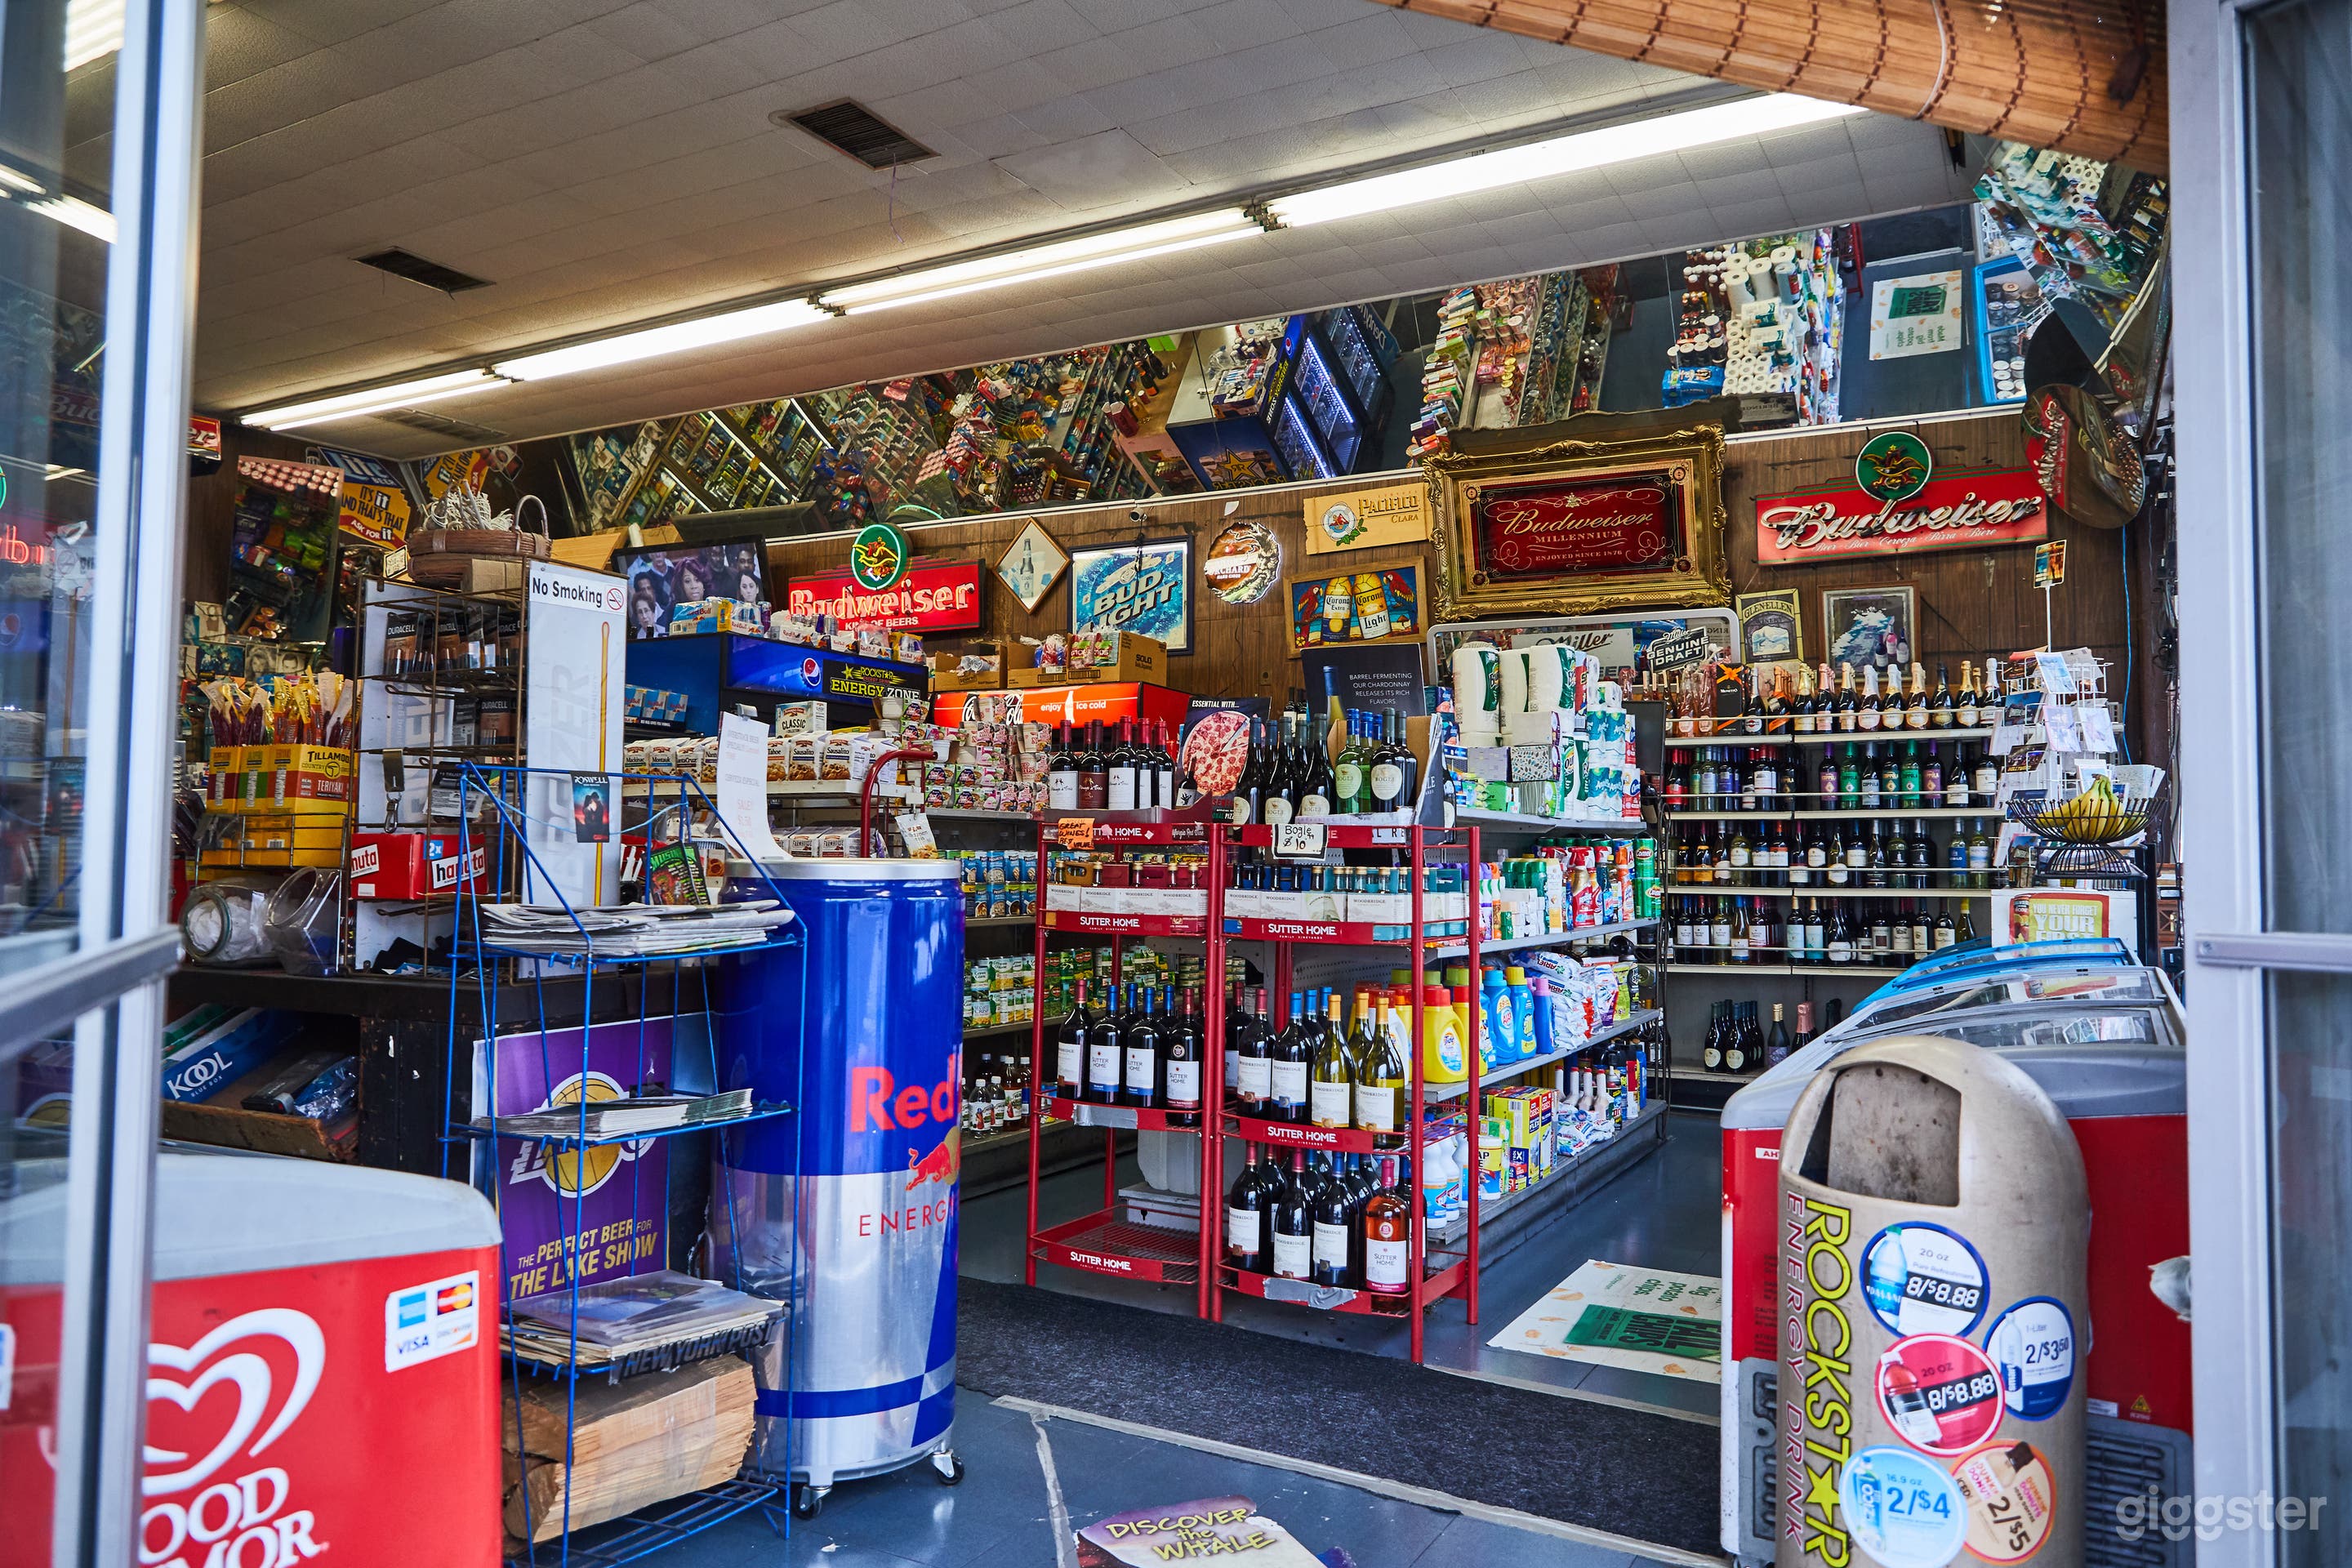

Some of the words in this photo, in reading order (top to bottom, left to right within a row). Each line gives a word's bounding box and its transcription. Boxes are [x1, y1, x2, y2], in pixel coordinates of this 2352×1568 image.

[1358, 495, 1419, 517] PACIFICO
[383, 509, 405, 532] THAT
[1391, 514, 1419, 524] CLARA
[1496, 507, 1655, 536] Budweiser
[1761, 492, 2042, 550] Budweiser
[350, 519, 366, 534] ASK
[365, 527, 381, 540] FOR
[1535, 530, 1623, 544] MILLENNIUM
[1811, 542, 1837, 554] Beer
[1845, 540, 1870, 550] Bier
[1878, 536, 1917, 549] Cerveza
[1925, 531, 1958, 543] Birra
[1535, 553, 1574, 562] ENJOYED
[1575, 551, 1601, 559] SINCE
[532, 577, 549, 596] No
[552, 580, 604, 608] Smoking
[789, 577, 976, 620] Budweiser
[1094, 570, 1165, 617] BUD
[1325, 595, 1351, 605] Corona
[1356, 591, 1384, 606] Corona
[387, 623, 416, 636] DURACELL
[885, 616, 920, 627] BEERS
[1363, 613, 1388, 630] Light
[1663, 628, 1691, 642] Miller
[1646, 635, 1713, 662] GENUINE
[1655, 647, 1703, 666] DRAFT
[831, 679, 885, 698] ENERGY
[886, 686, 921, 701] ZONE
[1355, 689, 1384, 697] RELEASES
[1365, 680, 1411, 688] CHARDONNAY
[481, 700, 509, 710] DURACELL
[1040, 703, 1062, 713] enjoy
[1076, 702, 1088, 710] ice
[1089, 700, 1107, 710] cold
[1192, 699, 1220, 709] ESSENTIAL
[782, 719, 807, 730] CLASSIC
[793, 748, 815, 756] Sausalito
[826, 746, 849, 755] Sausalito
[317, 779, 345, 794] TERIYAKI
[1058, 822, 1085, 831] GREAT
[1058, 826, 1090, 838] WINES!
[1115, 827, 1143, 837] HOME
[1285, 824, 1312, 837] Bogle
[427, 842, 443, 857] 2x
[2033, 903, 2047, 915] YOU
[2048, 904, 2070, 915] NEVER
[1080, 916, 1111, 927] SUTTER
[1112, 918, 1141, 929] HOME
[1267, 923, 1304, 935] SUTTER
[1306, 925, 1338, 937] HOME
[2034, 914, 2096, 933] YOUR
[166, 1051, 234, 1100] KOOL
[190, 1085, 207, 1098] BLUE
[208, 1075, 224, 1086] BOX
[849, 1049, 962, 1134] Red
[1267, 1125, 1303, 1140] SUTTER
[1305, 1131, 1338, 1143] HOME
[518, 1253, 534, 1271] THE
[600, 1218, 635, 1245] BEER
[635, 1218, 653, 1232] FOR
[1918, 1247, 1935, 1259] 20
[1070, 1251, 1102, 1266] SUTTER
[1102, 1258, 1133, 1271] HOME
[1374, 1253, 1397, 1261] SUTTER
[510, 1272, 546, 1301] THE
[551, 1248, 600, 1287] LAKE
[604, 1232, 658, 1271] SHOW
[1930, 1265, 1976, 1281] Refreshment
[1633, 1278, 1664, 1296] chips.
[1657, 1281, 1688, 1303] potato
[1688, 1285, 1713, 1297] big
[1786, 1190, 1805, 1388] ENERGY
[1905, 1276, 1980, 1309] 8/$8.88
[1618, 1314, 1675, 1348] CHIPS
[1664, 1320, 1722, 1350] FAIL
[396, 1334, 430, 1356] VISA
[623, 1343, 671, 1378] NEW
[673, 1329, 728, 1370] YORK
[731, 1320, 777, 1350] POST
[1921, 1365, 1936, 1379] 20
[1927, 1374, 1996, 1411] 8/$8.88
[1786, 1400, 1805, 1552] DRINK
[1886, 1472, 1908, 1485] 16.9
[1886, 1486, 1952, 1519] 2/$4
[2019, 1481, 2042, 1519] DONUTS
[140, 1467, 290, 1565] OOD
[1105, 1508, 1250, 1539] DISCOVER
[1987, 1495, 2031, 1552] 2/$5
[1177, 1528, 1215, 1542] the
[1152, 1530, 1276, 1561] WHALE
